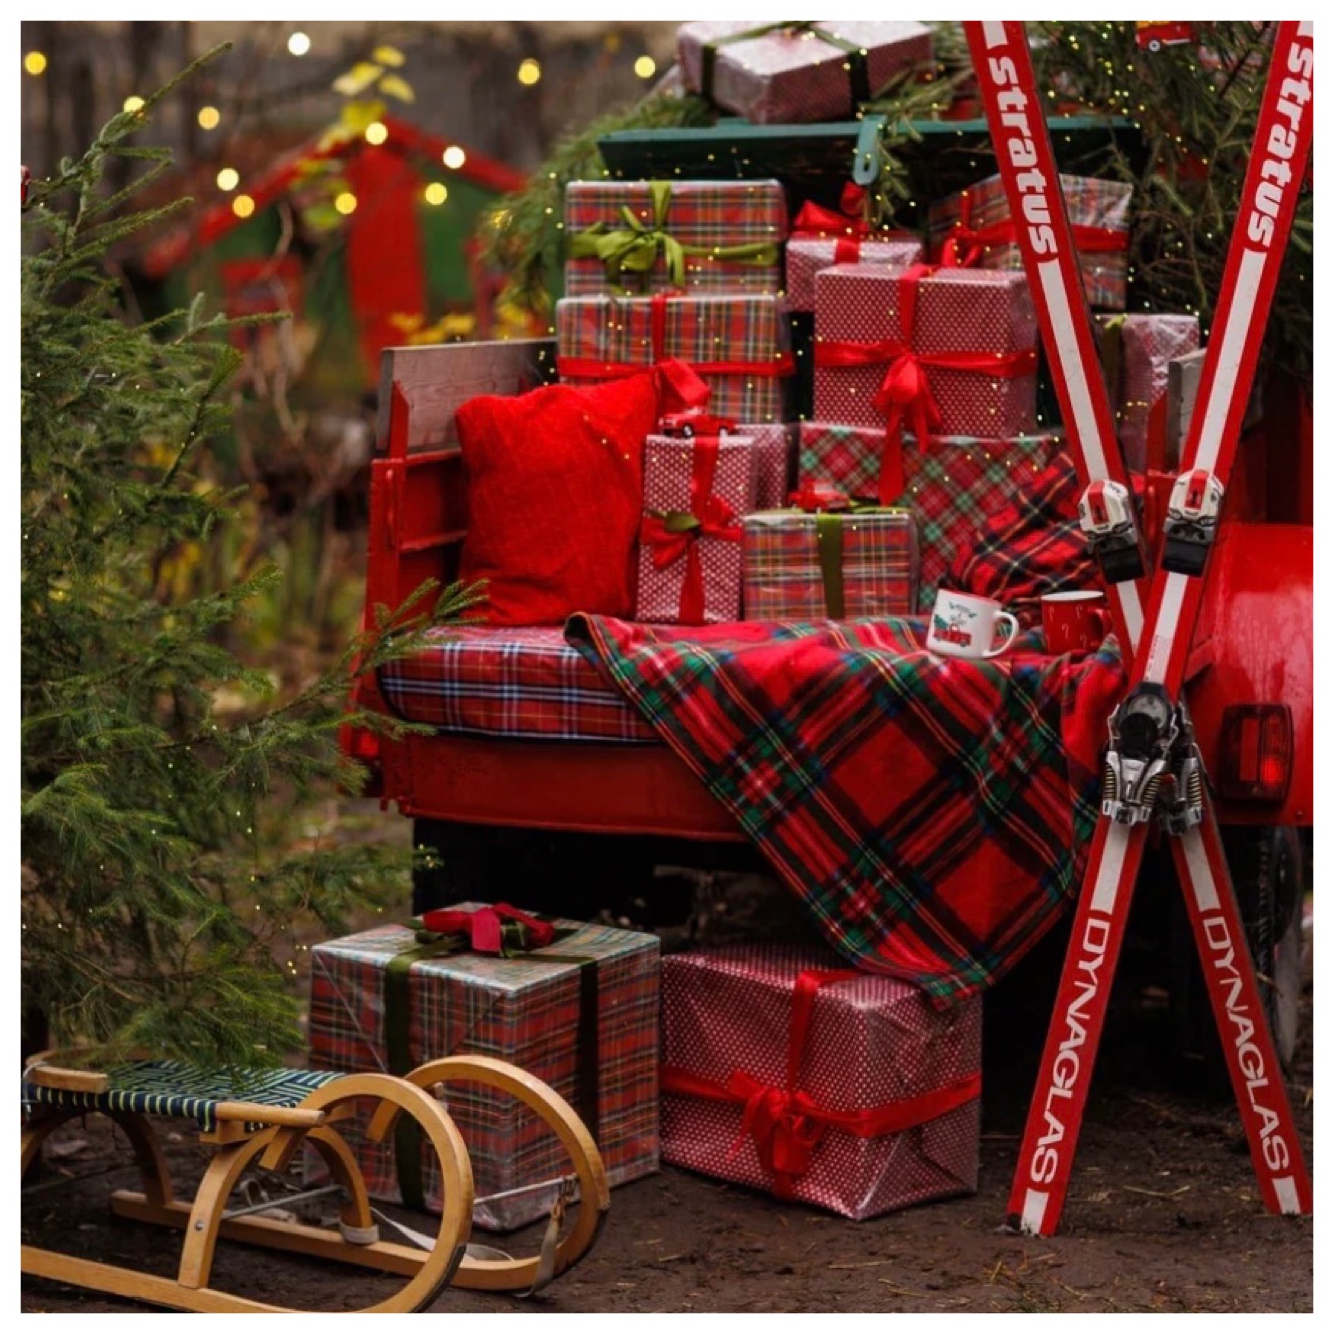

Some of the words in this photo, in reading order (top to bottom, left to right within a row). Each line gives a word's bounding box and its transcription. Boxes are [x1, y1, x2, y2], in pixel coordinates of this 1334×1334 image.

[988, 56, 1058, 255] stratus
[1247, 42, 1314, 247] stratus
[1030, 918, 1110, 1184] DYNAGLAS
[1204, 916, 1289, 1171] DYNAGLAS
